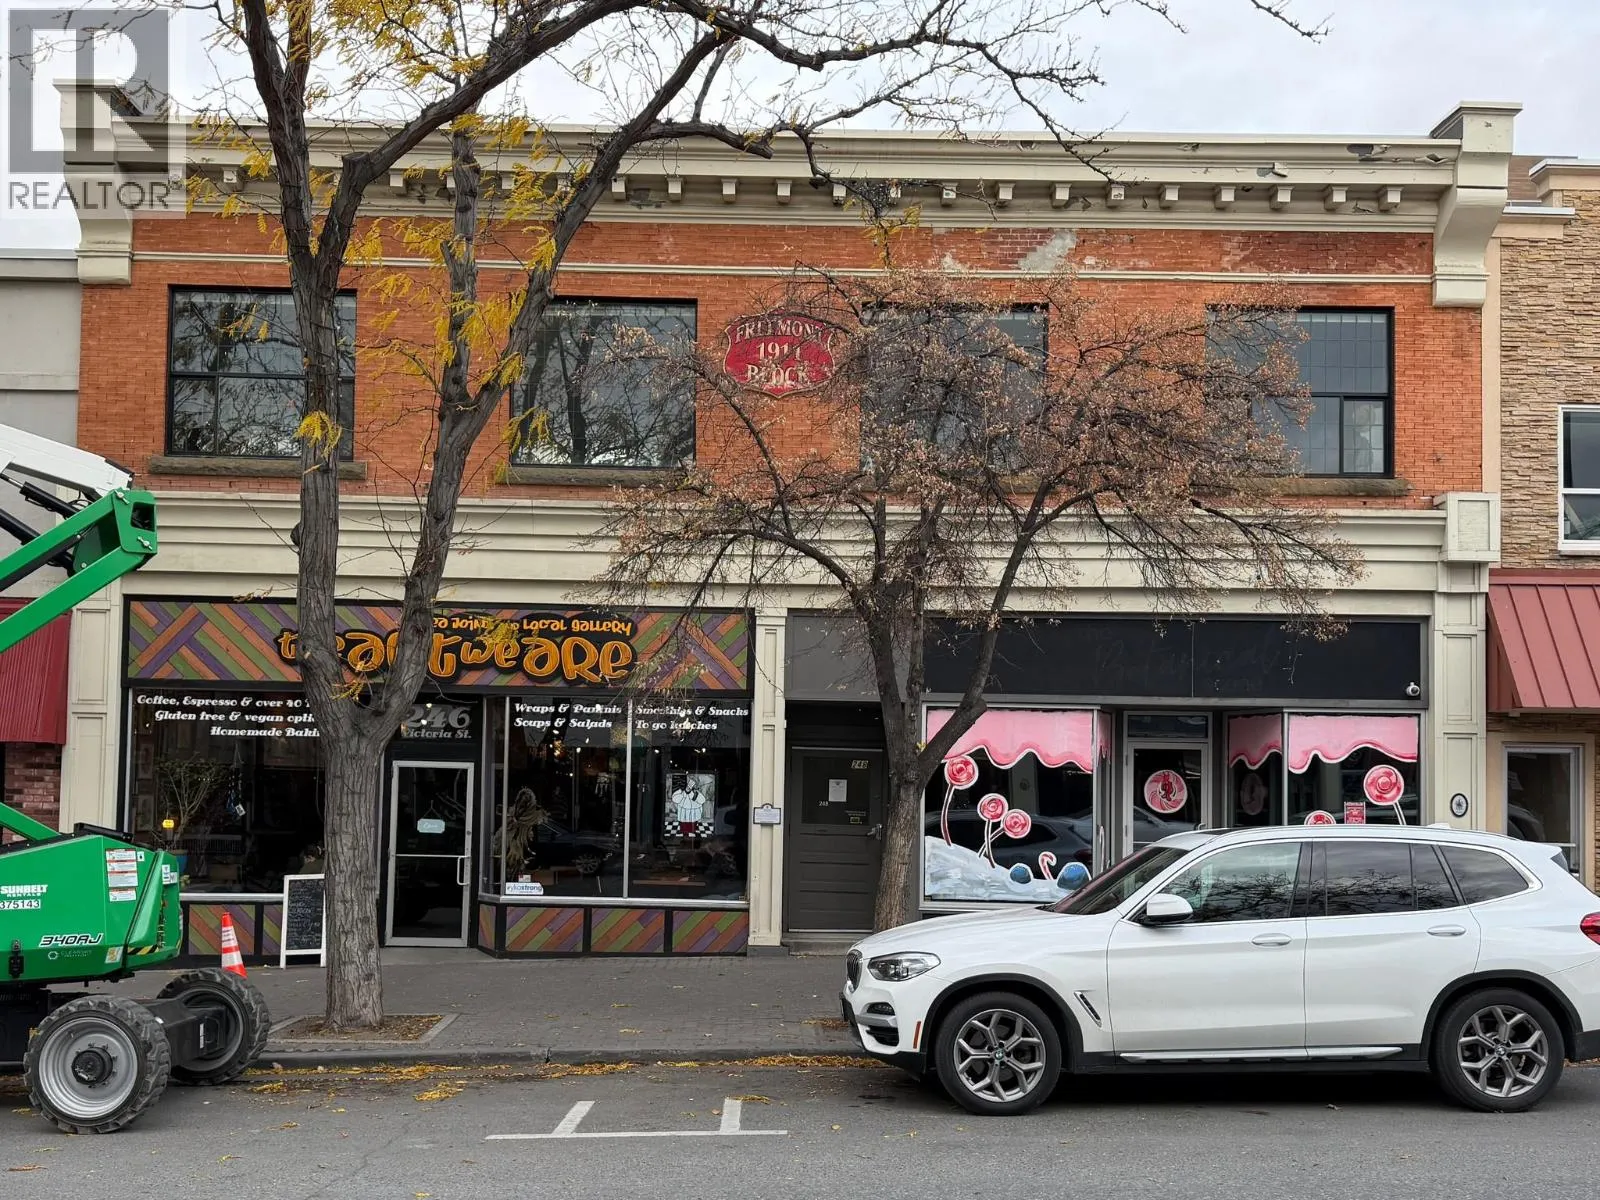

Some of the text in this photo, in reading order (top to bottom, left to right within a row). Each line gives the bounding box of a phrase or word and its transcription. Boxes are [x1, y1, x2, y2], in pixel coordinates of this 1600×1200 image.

[137, 695, 180, 706] Coffee,
[182, 696, 238, 707] Espresso
[240, 696, 252, 707] &
[255, 700, 283, 708] over
[514, 703, 555, 714] Wraps
[558, 703, 570, 713] &
[695, 705, 706, 716] &
[708, 706, 749, 716] Snacks
[155, 710, 315, 724] Gluten free & vegan opti
[405, 704, 472, 729] 246
[514, 717, 613, 729] Soups & Salads
[635, 719, 718, 730] To go luches
[210, 726, 283, 737] Homemade
[455, 729, 472, 739] St.
[0, 884, 48, 894] SUNBELT
[40, 933, 103, 947] 340AJ
